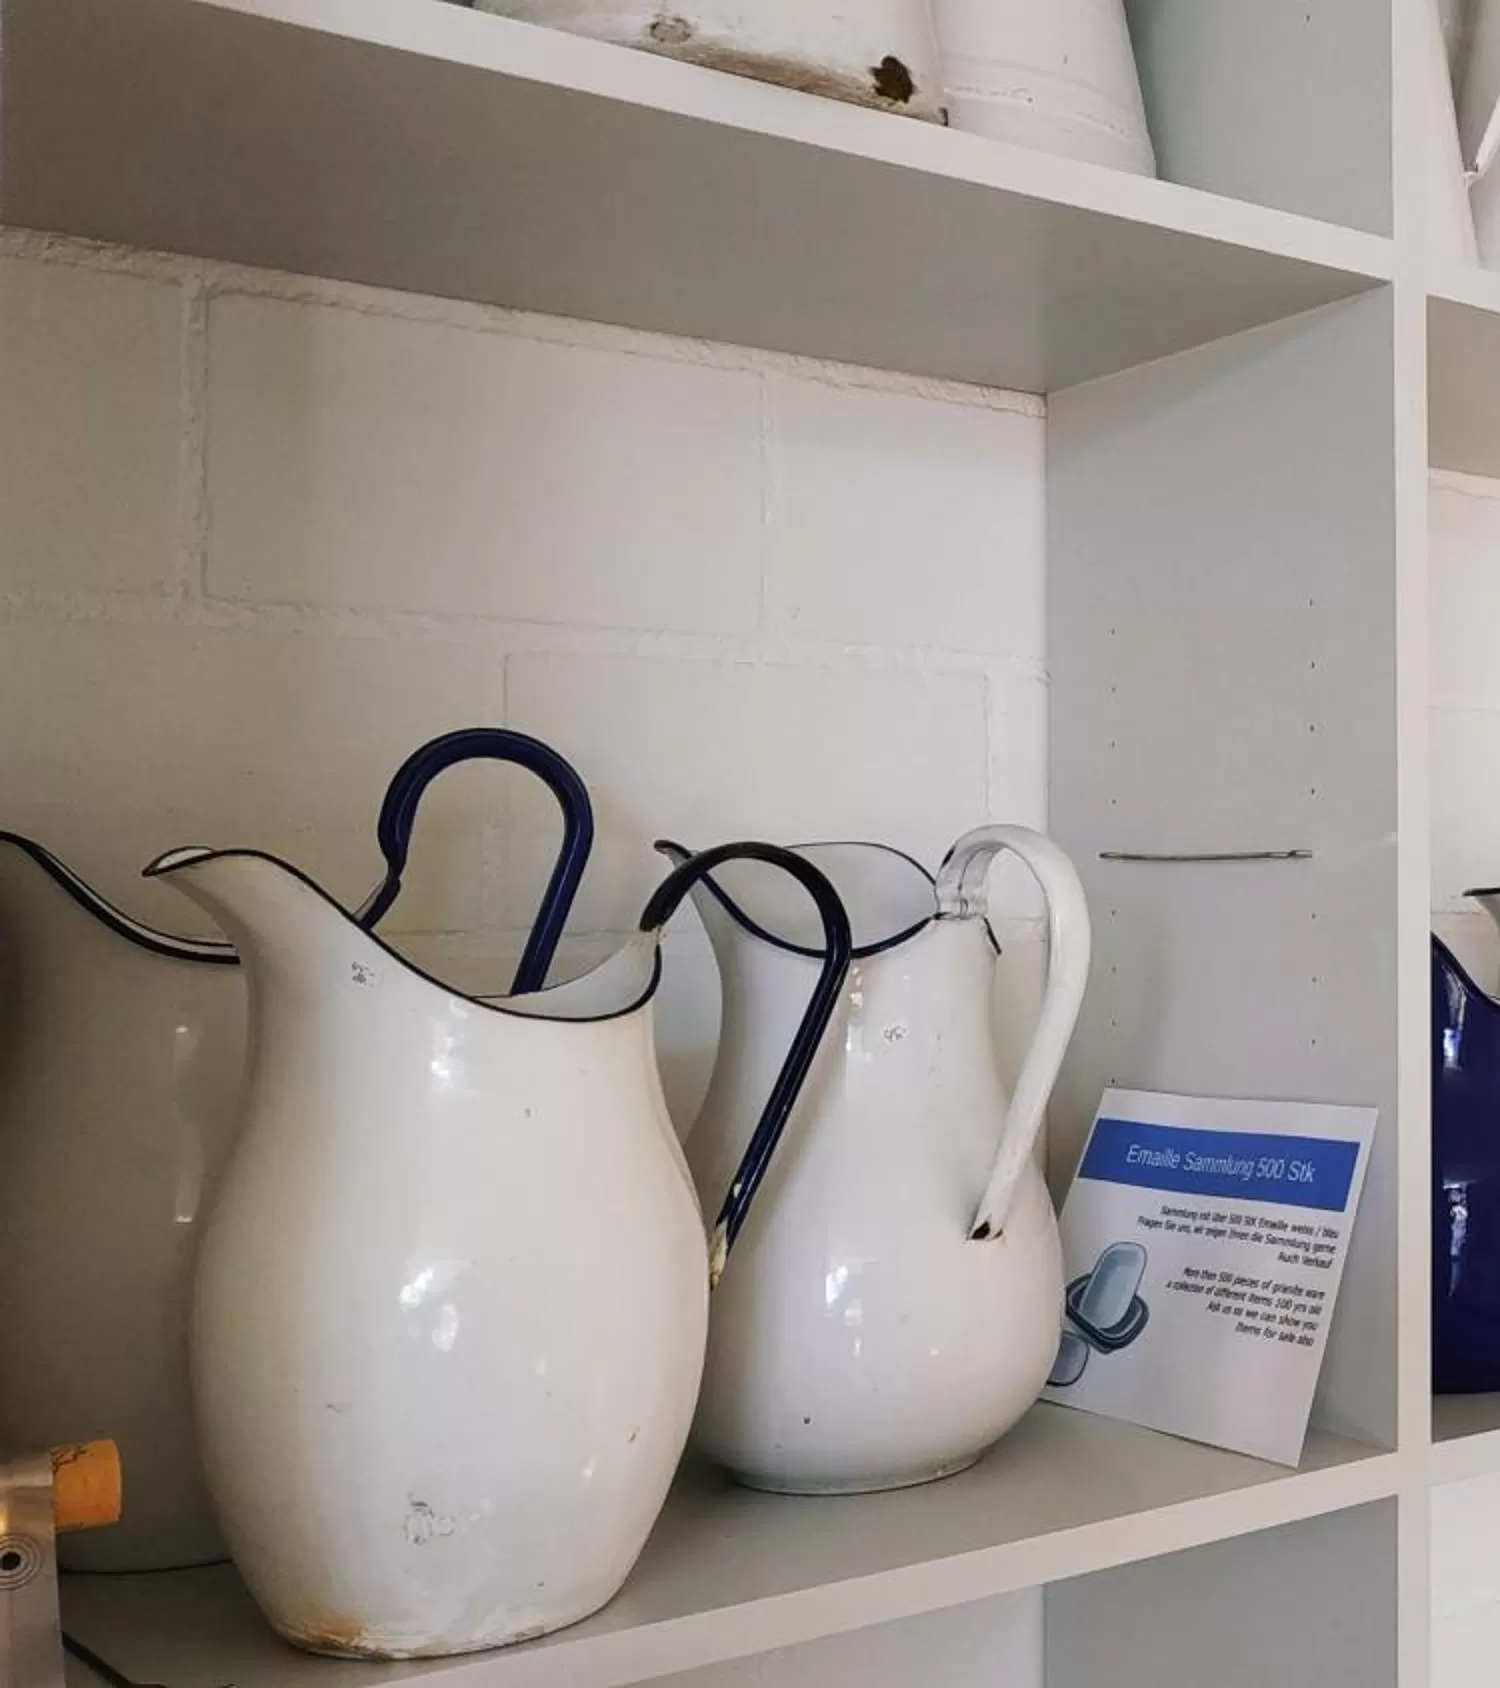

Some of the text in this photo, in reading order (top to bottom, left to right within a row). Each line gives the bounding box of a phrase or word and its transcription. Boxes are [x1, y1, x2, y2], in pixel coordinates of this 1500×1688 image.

[1126, 1143, 1316, 1184] Emaille Sammlung 500 Stk
[1265, 1233, 1311, 1253] Sammlung
[1277, 1251, 1300, 1264] Auch
